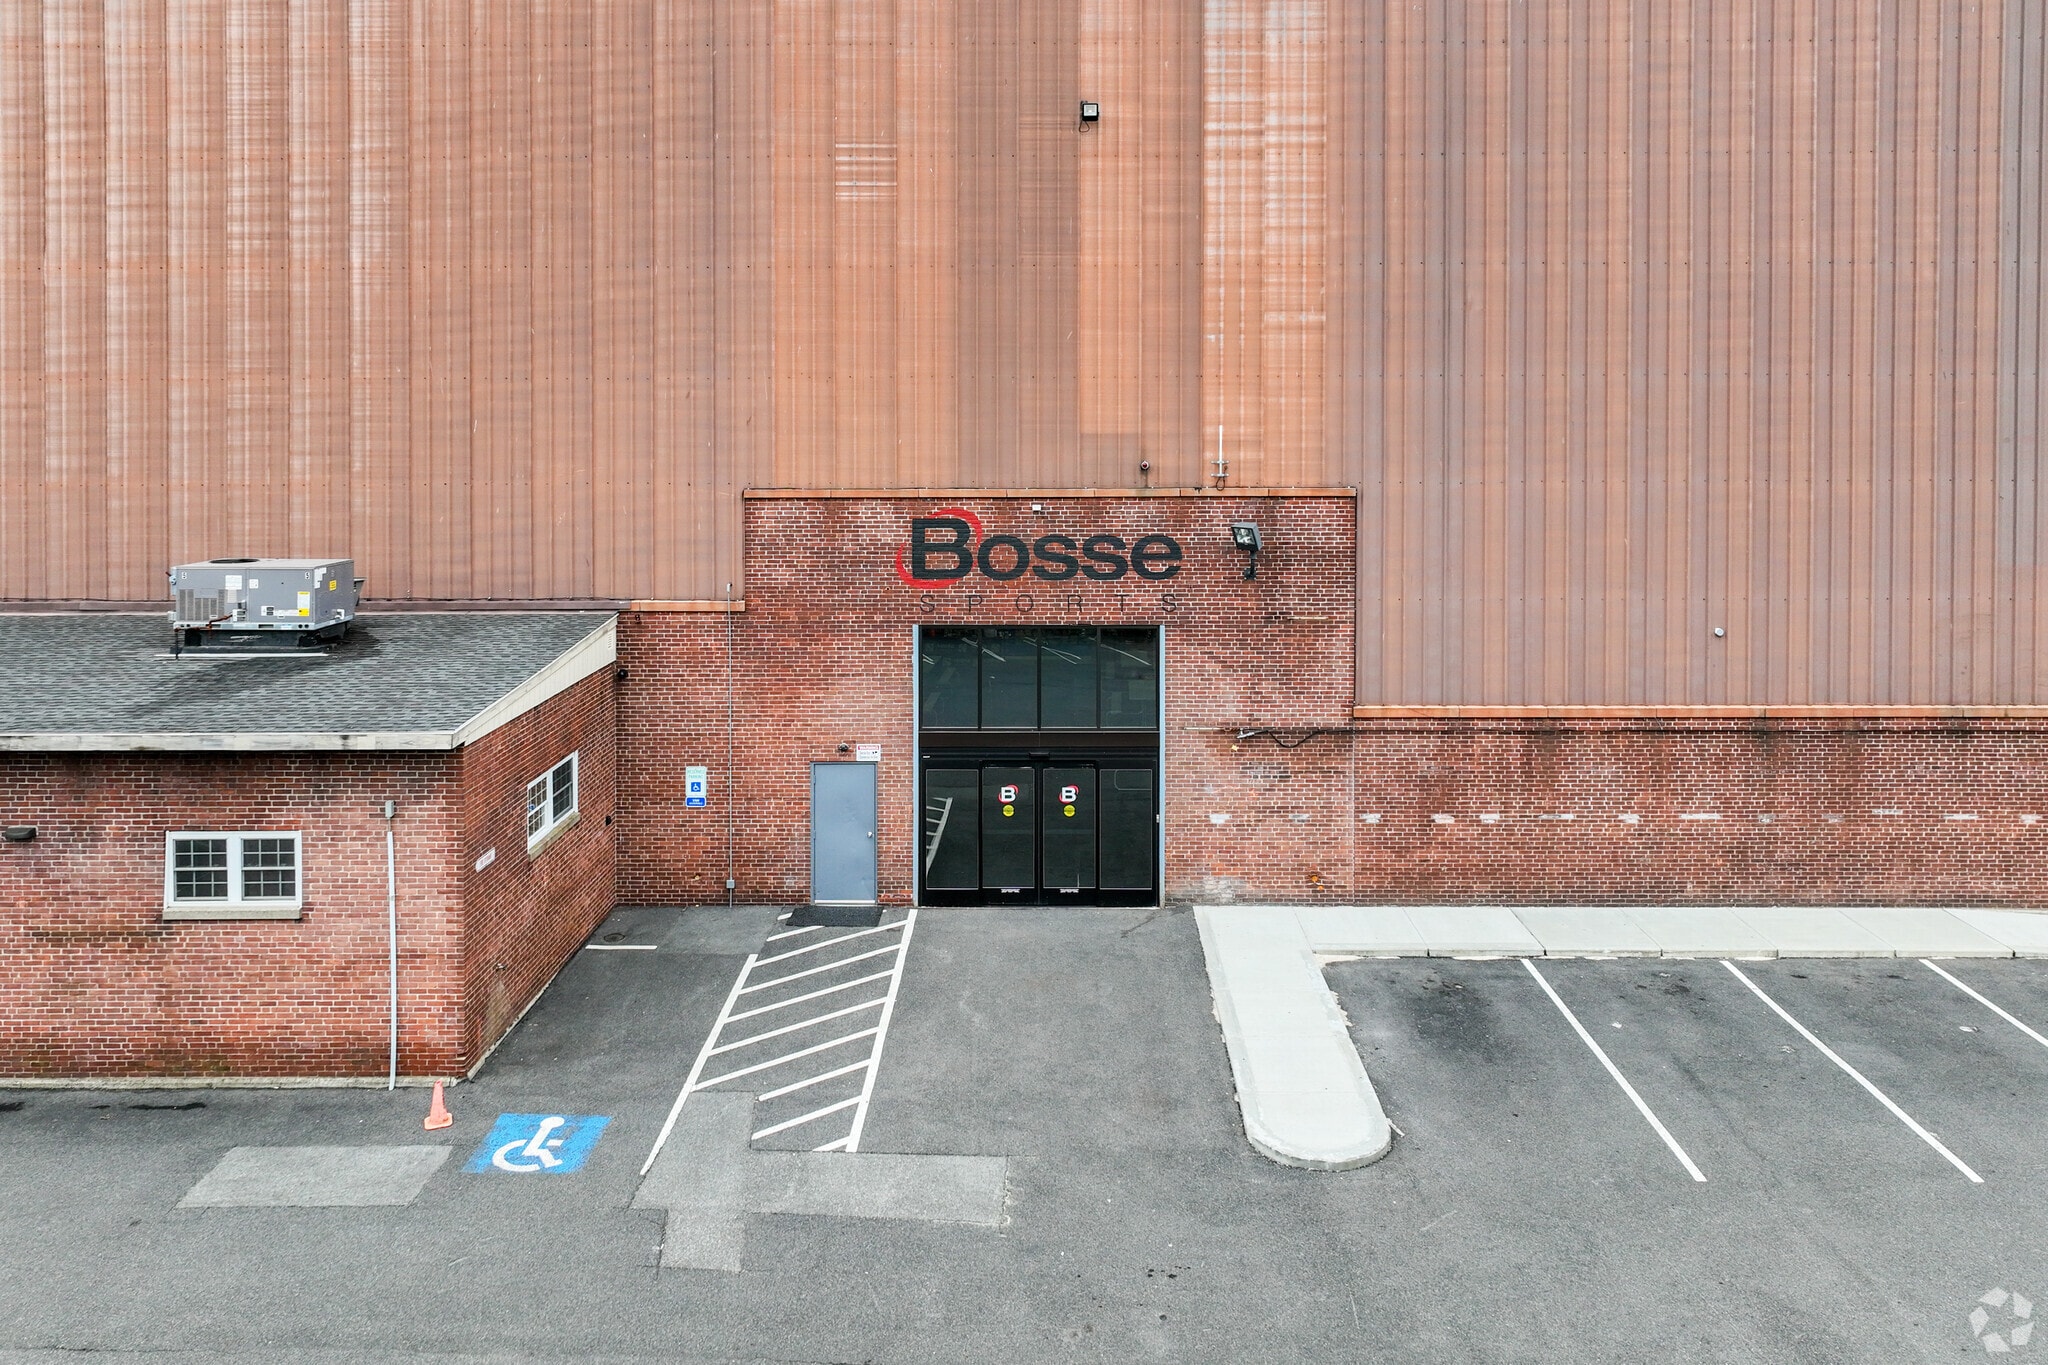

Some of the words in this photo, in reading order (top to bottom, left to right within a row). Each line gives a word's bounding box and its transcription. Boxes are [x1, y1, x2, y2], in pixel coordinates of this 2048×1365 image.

[912, 518, 1183, 581] Bosse
[919, 594, 1178, 614] SPORTS
[1001, 787, 1016, 802] B
[1061, 787, 1077, 802] B
